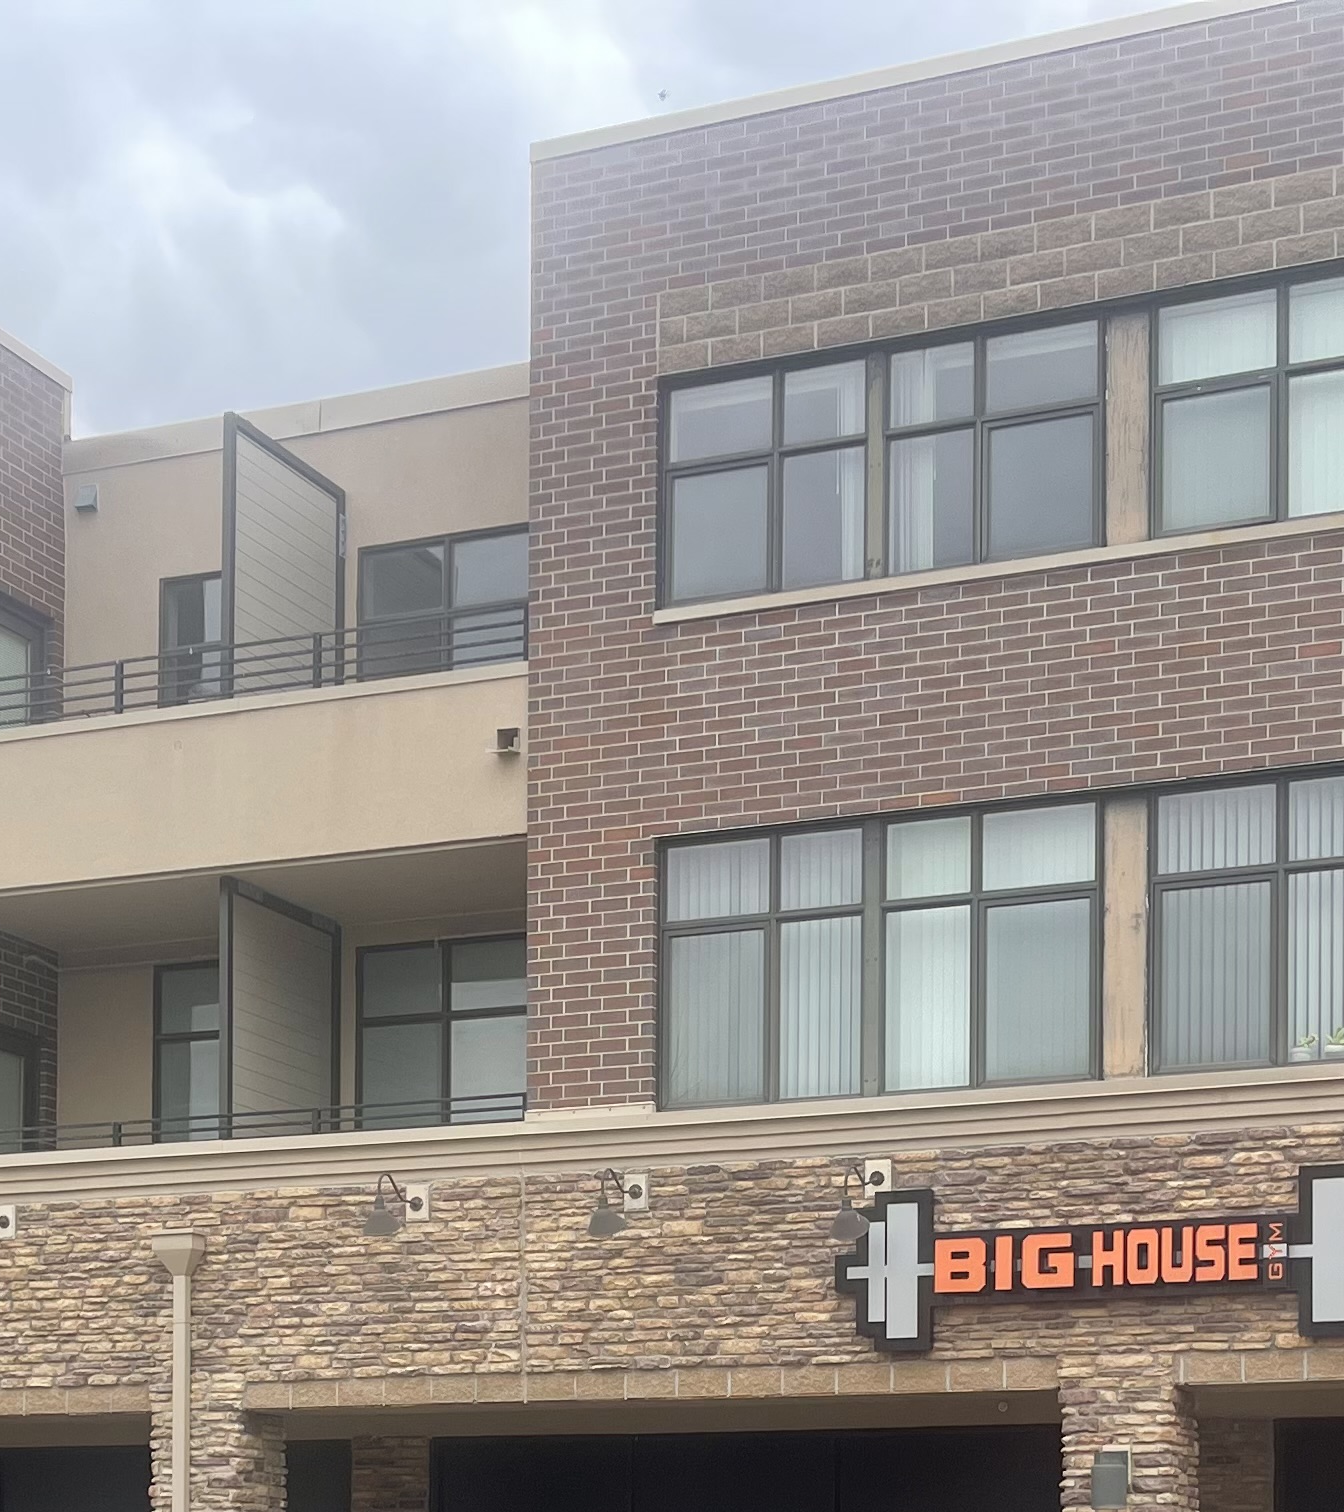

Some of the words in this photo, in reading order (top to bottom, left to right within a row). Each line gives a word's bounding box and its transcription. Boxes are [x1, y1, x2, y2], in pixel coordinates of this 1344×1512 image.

[934, 1232, 1075, 1294] BIG
[1092, 1222, 1259, 1288] HOUSE
[1268, 1222, 1284, 1281] GYM
